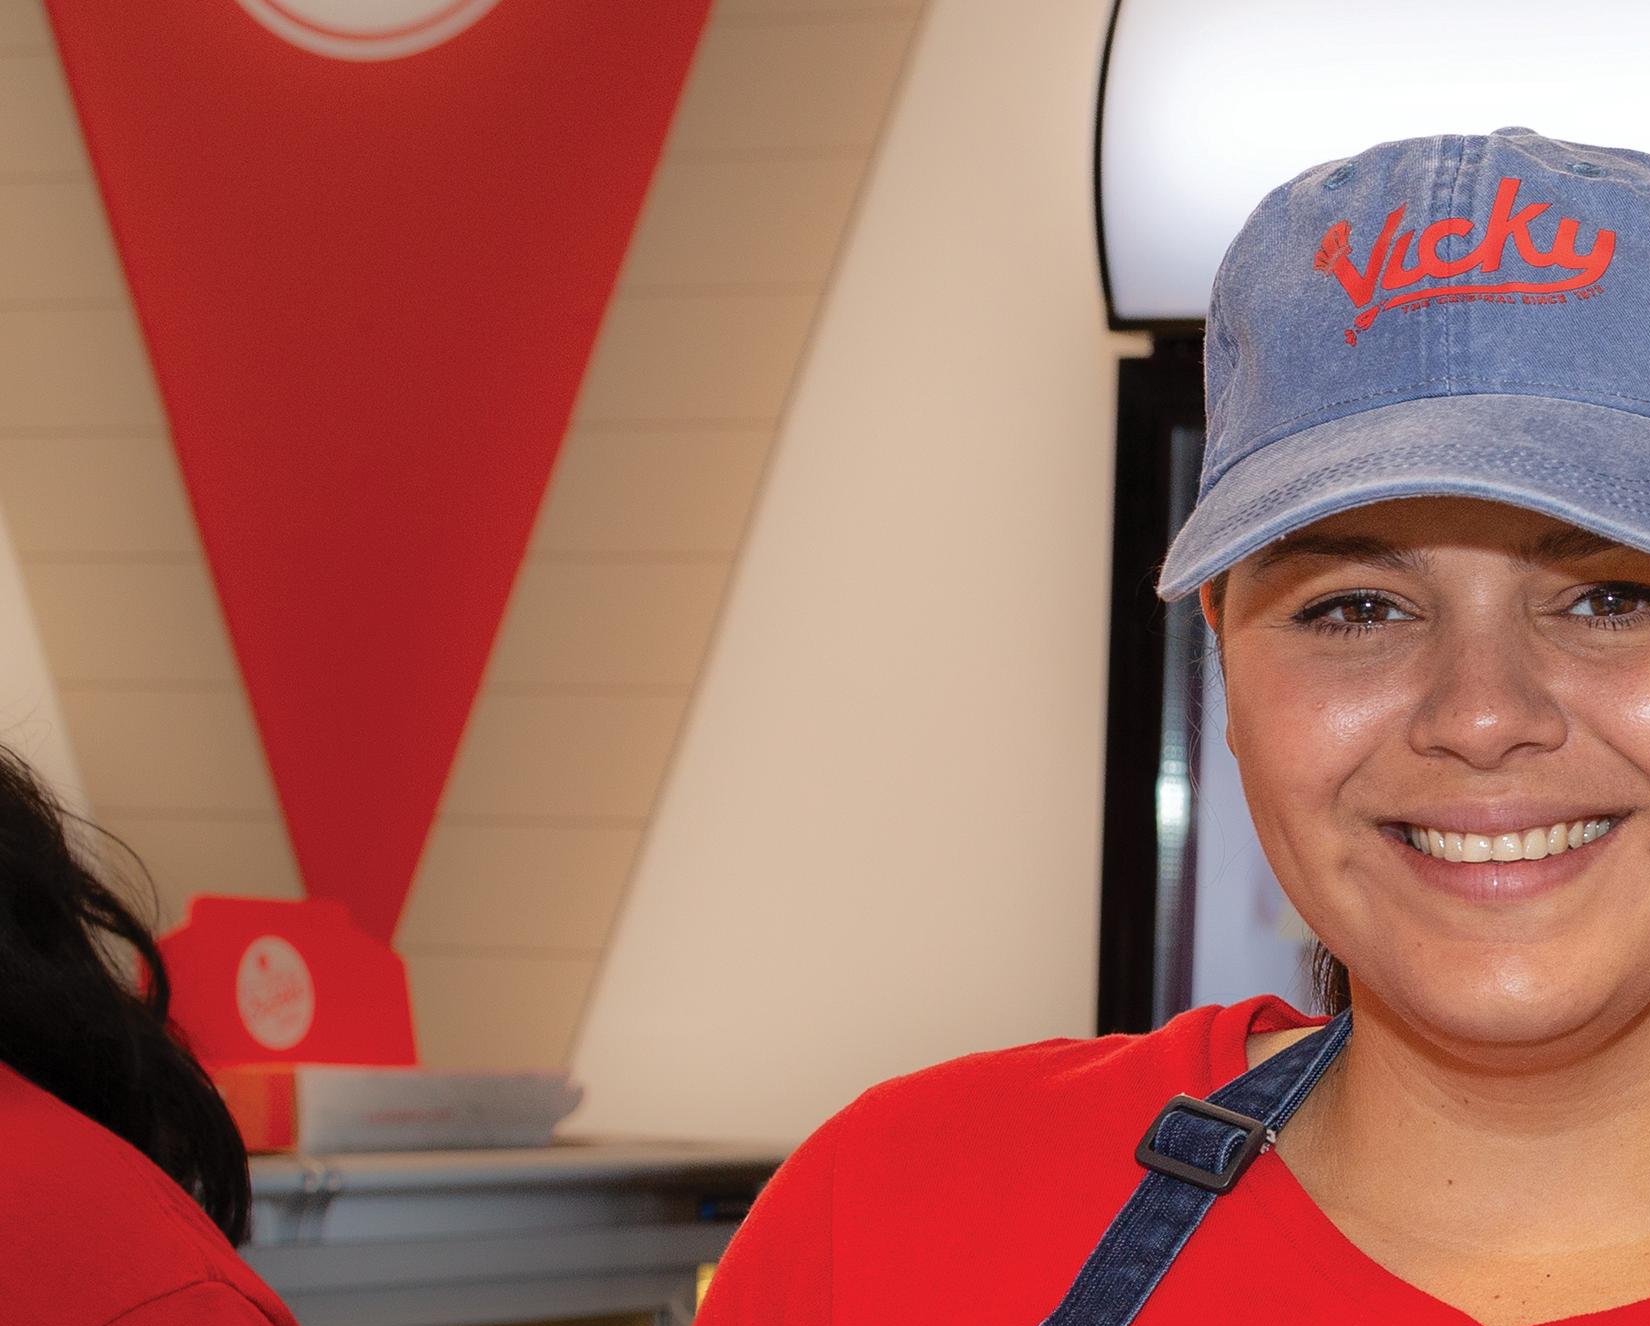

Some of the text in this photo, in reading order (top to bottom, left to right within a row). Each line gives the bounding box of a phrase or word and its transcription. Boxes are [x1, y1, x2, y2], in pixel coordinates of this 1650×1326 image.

[1330, 177, 1617, 312] Vicky
[1401, 300, 1430, 314] THE
[1522, 294, 1567, 305] SINCE
